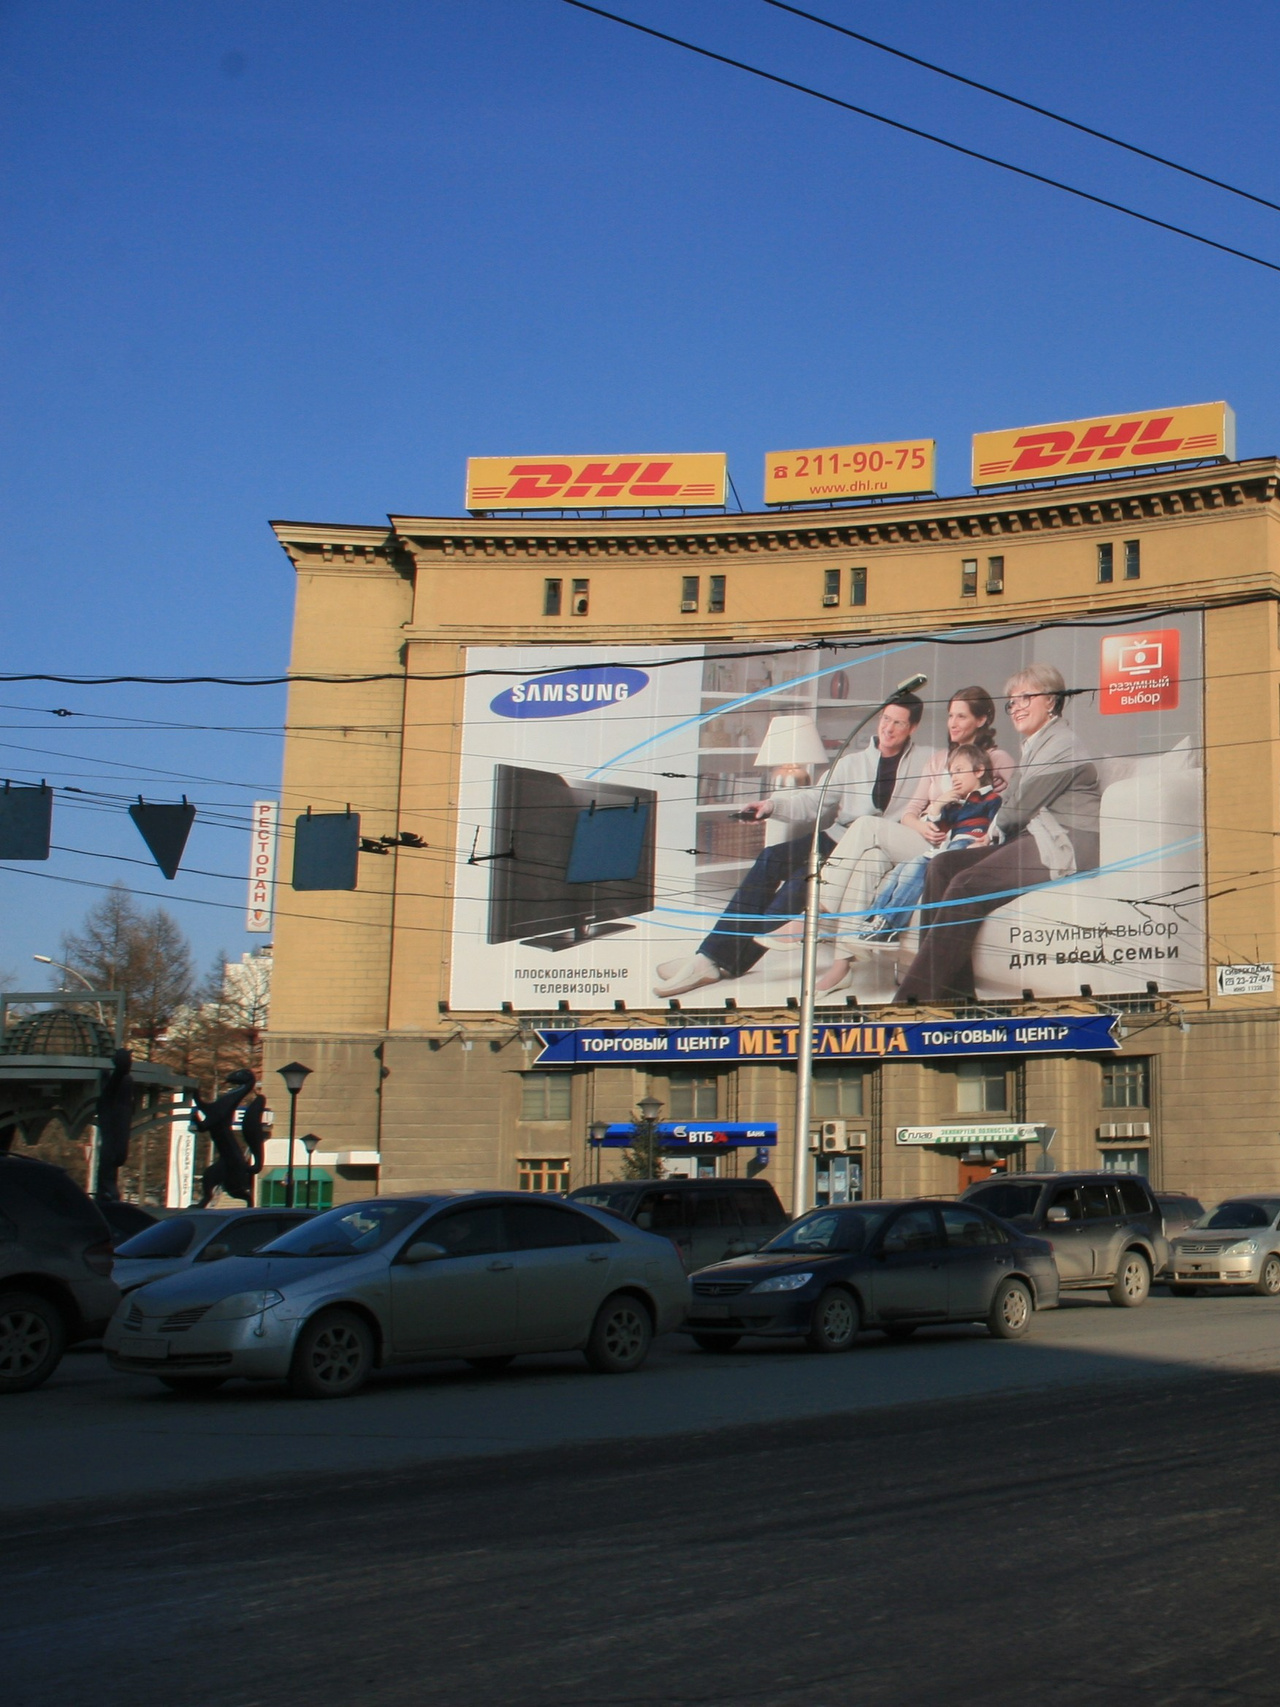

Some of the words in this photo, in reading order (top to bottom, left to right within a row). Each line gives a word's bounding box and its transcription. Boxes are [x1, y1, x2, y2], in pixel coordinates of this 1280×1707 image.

[1010, 416, 1185, 472] DHL
[795, 448, 925, 477] 211-90-75
[504, 463, 683, 499] DHL
[810, 480, 888, 495] www.dhl.ru
[512, 683, 629, 703] SAMSUNG
[1109, 676, 1169, 694] разумный
[1121, 691, 1160, 706] выбор
[254, 805, 271, 902] РЕСТОРАН
[1009, 922, 1108, 946] Разумный
[1115, 920, 1178, 938] выбор
[1009, 952, 1047, 969] для
[1056, 945, 1105, 965] всей
[1113, 945, 1179, 961] семьи
[515, 968, 628, 979] плоскопанельные
[533, 983, 610, 996] телевизоры
[582, 1034, 668, 1052] ТОРГОВЫЙ
[677, 1036, 731, 1052] ЦЕНТР
[738, 1027, 909, 1057] МЕТЕЛИЦА
[922, 1026, 1008, 1046] ТОРГОВЫЙ
[1015, 1027, 1069, 1044] ЦЕНТР
[746, 1130, 766, 1138] БАНК
[898, 1128, 933, 1142] Сплав
